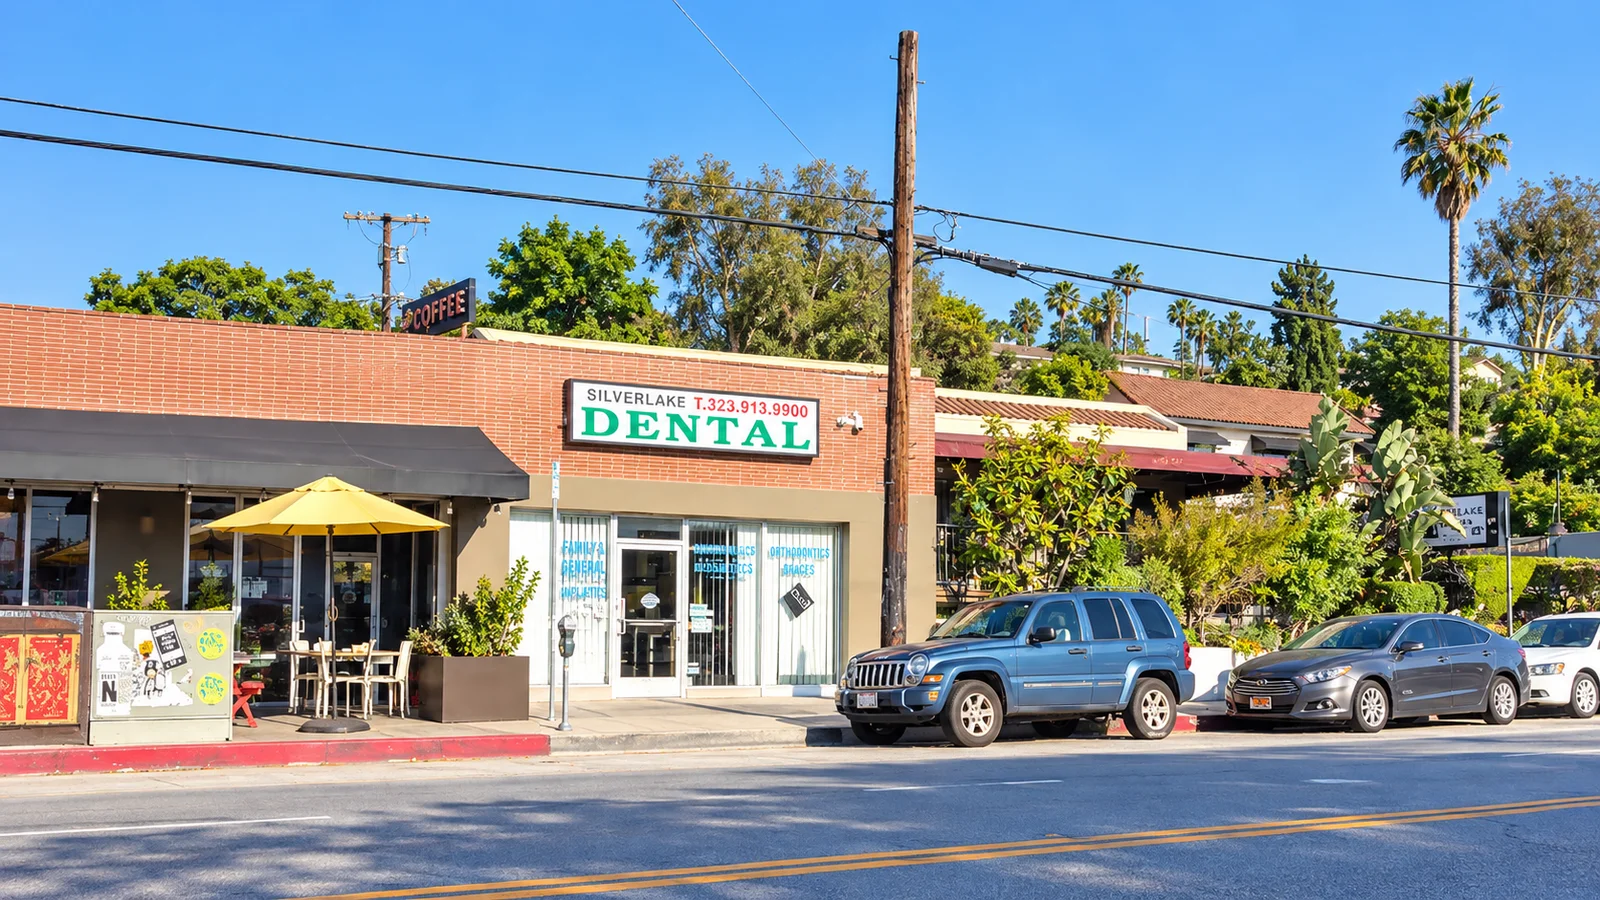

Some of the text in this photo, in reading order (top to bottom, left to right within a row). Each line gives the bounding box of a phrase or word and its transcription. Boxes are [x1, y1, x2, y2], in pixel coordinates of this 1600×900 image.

[413, 289, 466, 330] COFFEE
[586, 388, 808, 418] SILVERLAKE T.323.913.9900
[580, 406, 811, 450] DENTAL
[561, 539, 597, 555] FAMILY
[770, 546, 830, 559] ORTHODONTICS
[561, 559, 606, 576] GENERAL
